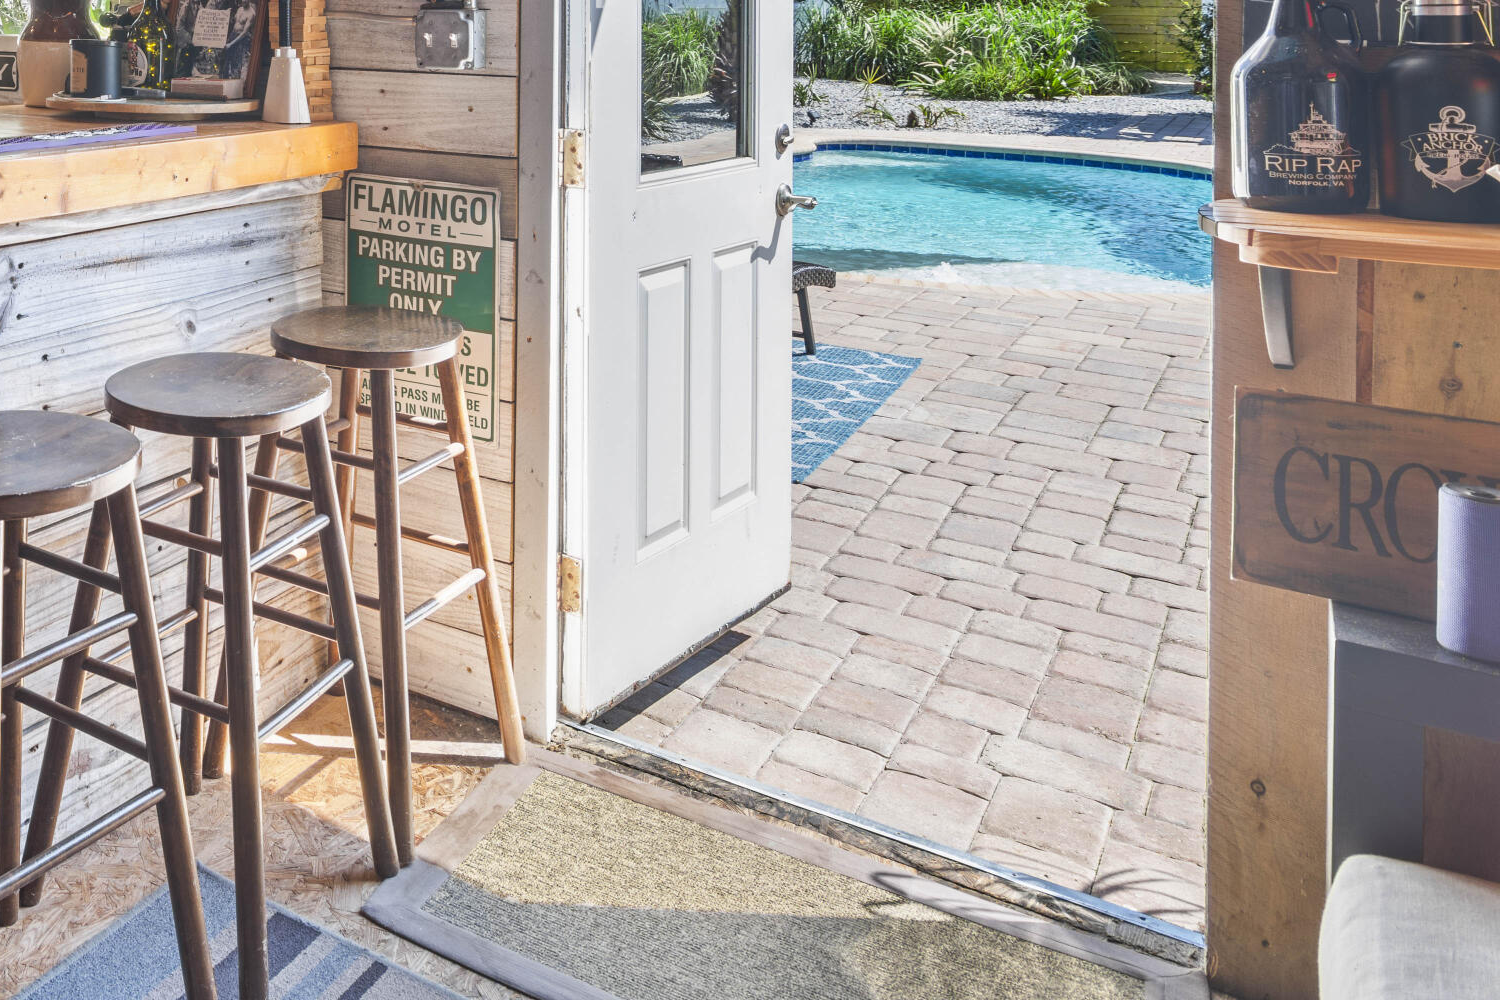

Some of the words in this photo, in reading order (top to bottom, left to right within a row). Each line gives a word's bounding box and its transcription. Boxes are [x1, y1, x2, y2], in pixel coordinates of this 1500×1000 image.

[1422, 141, 1483, 155] ANCHOR
[1428, 132, 1479, 145] BRICK
[1264, 155, 1303, 172] RIP
[1316, 156, 1363, 174] RAP
[1269, 171, 1313, 181] BREWING
[1315, 173, 1358, 181] COMPANY
[1331, 180, 1346, 188] VA
[353, 183, 489, 227] FLAMINGO
[378, 216, 458, 240] MOTEL
[357, 235, 446, 269] PARKING
[451, 248, 482, 274] BY
[377, 264, 458, 297] PERMIT
[400, 386, 429, 402] PASS
[466, 398, 481, 413] BE
[405, 403, 418, 416] IN
